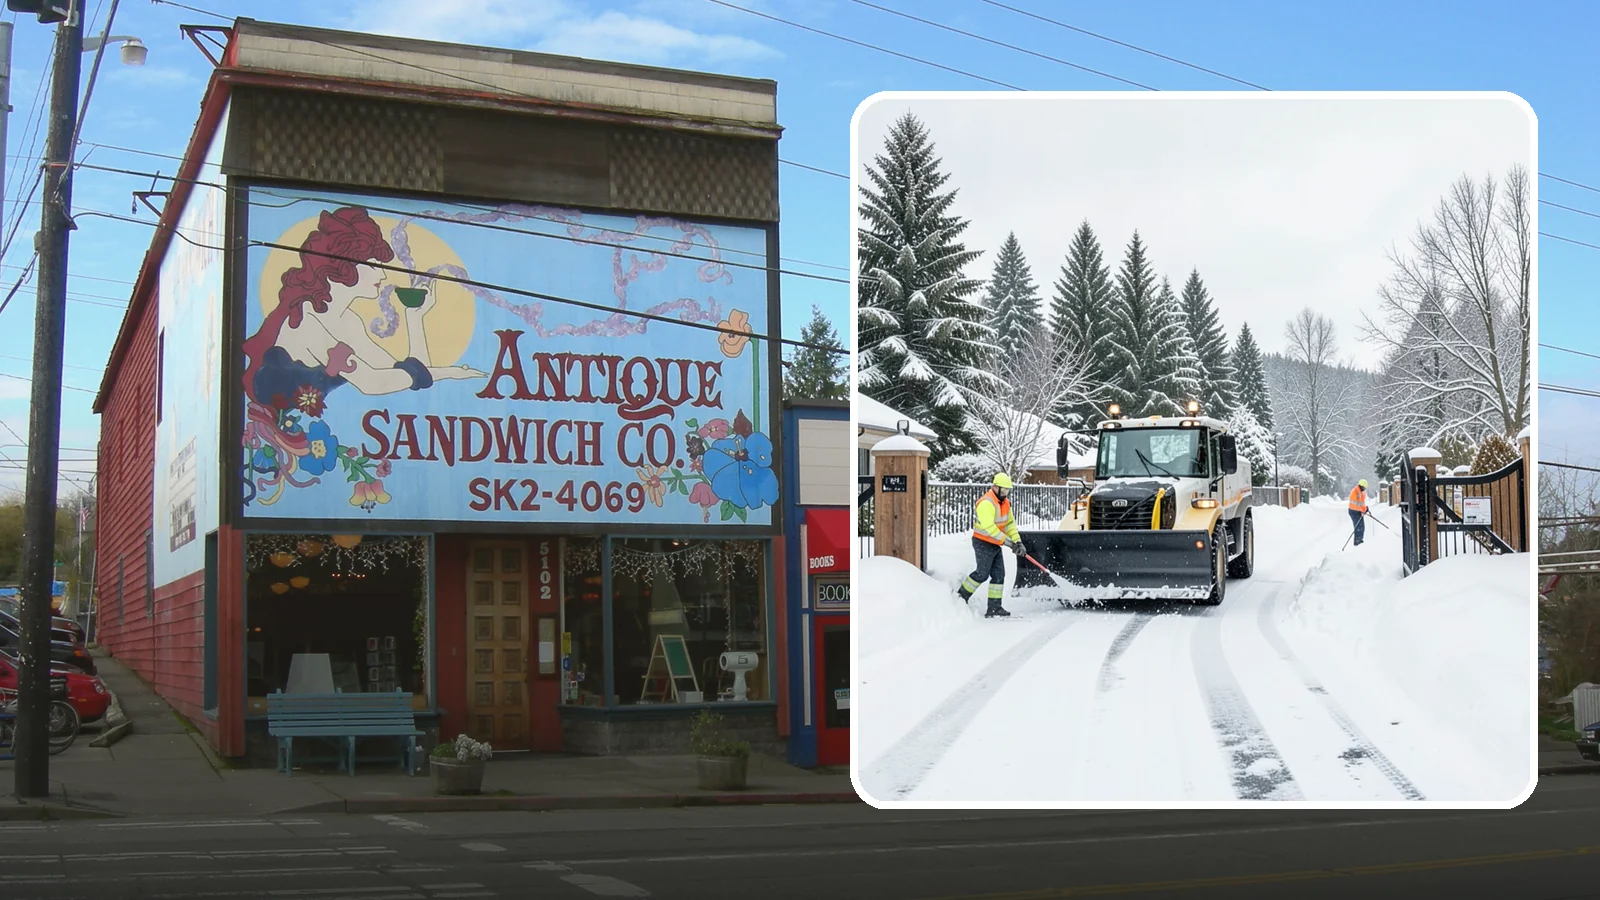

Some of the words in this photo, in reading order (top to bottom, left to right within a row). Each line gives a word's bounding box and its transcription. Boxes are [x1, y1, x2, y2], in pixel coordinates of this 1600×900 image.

[361, 408, 605, 467] SANDWICH
[617, 422, 686, 468] CO.
[468, 477, 645, 512] SK2-4069
[540, 541, 552, 600] 5102
[809, 555, 835, 569] BOOKS
